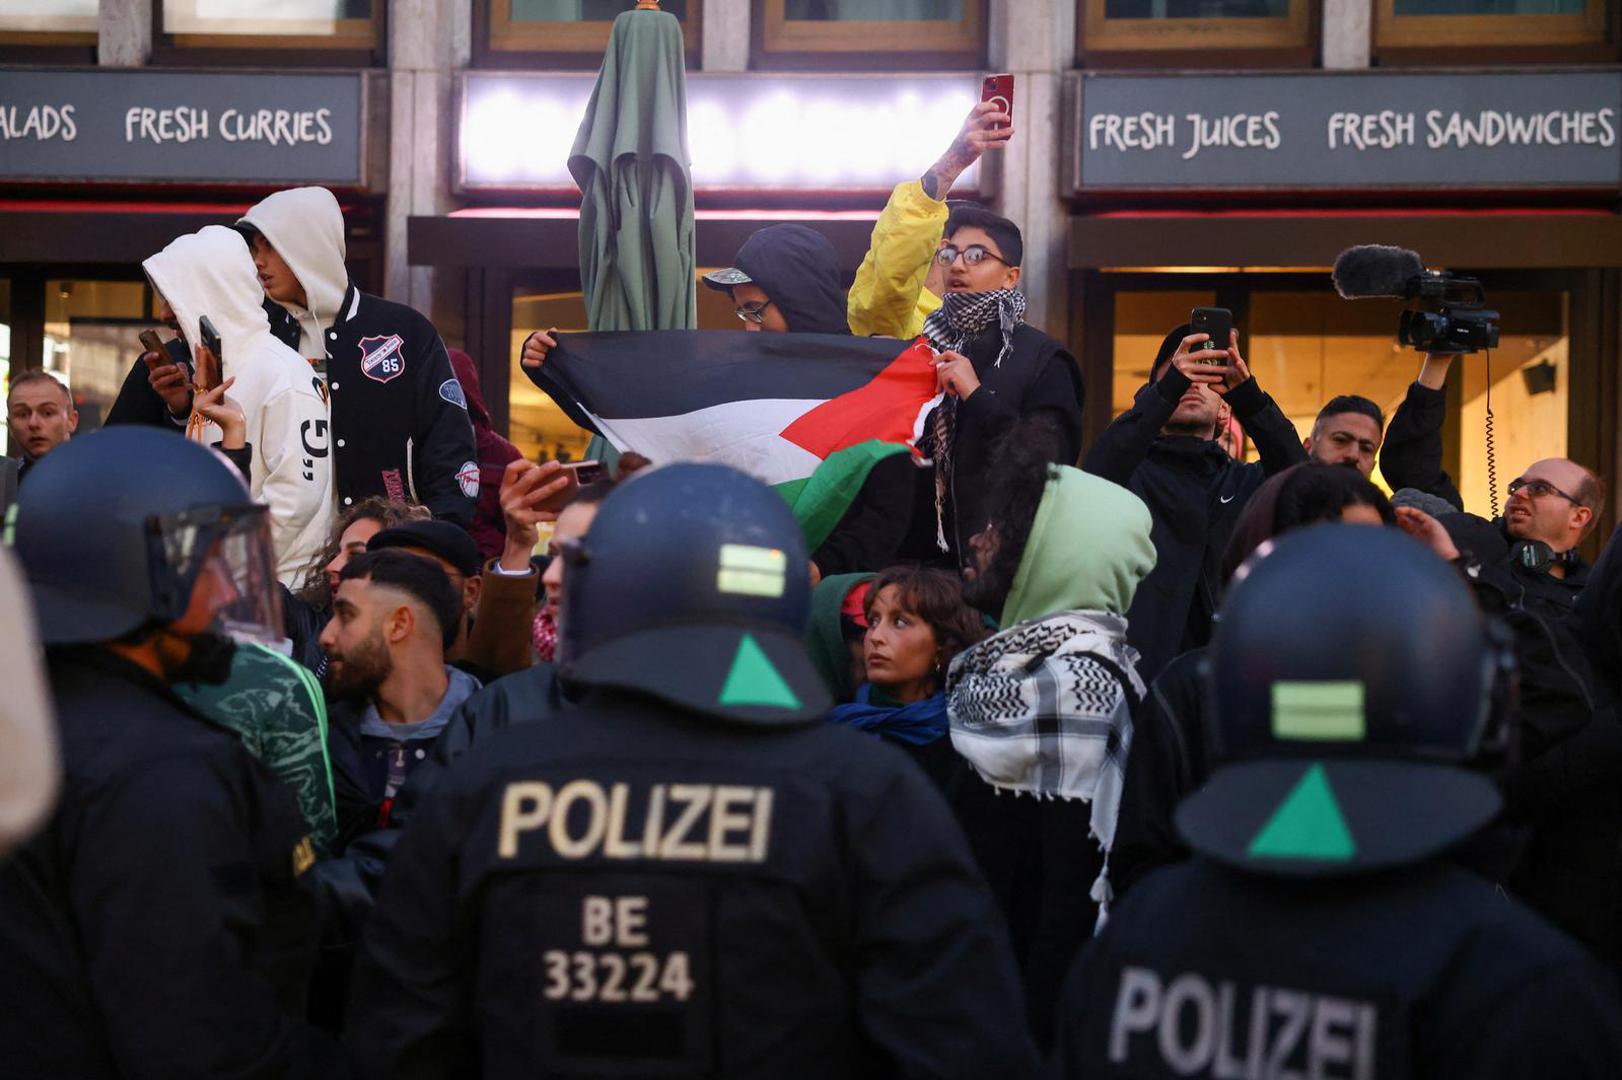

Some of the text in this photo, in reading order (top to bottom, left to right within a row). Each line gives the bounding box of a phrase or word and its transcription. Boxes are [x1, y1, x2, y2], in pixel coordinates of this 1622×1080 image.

[126, 106, 332, 146] FRESH CURRIES
[1089, 111, 1281, 159] FRESH JUICES
[1328, 107, 1616, 151] FRESH SANDWICHES
[382, 358, 399, 372] 85
[498, 779, 773, 862] POLIZEI
[582, 895, 648, 946] BE
[544, 950, 693, 1001] 33224
[1108, 965, 1378, 1080] POLIZEI
